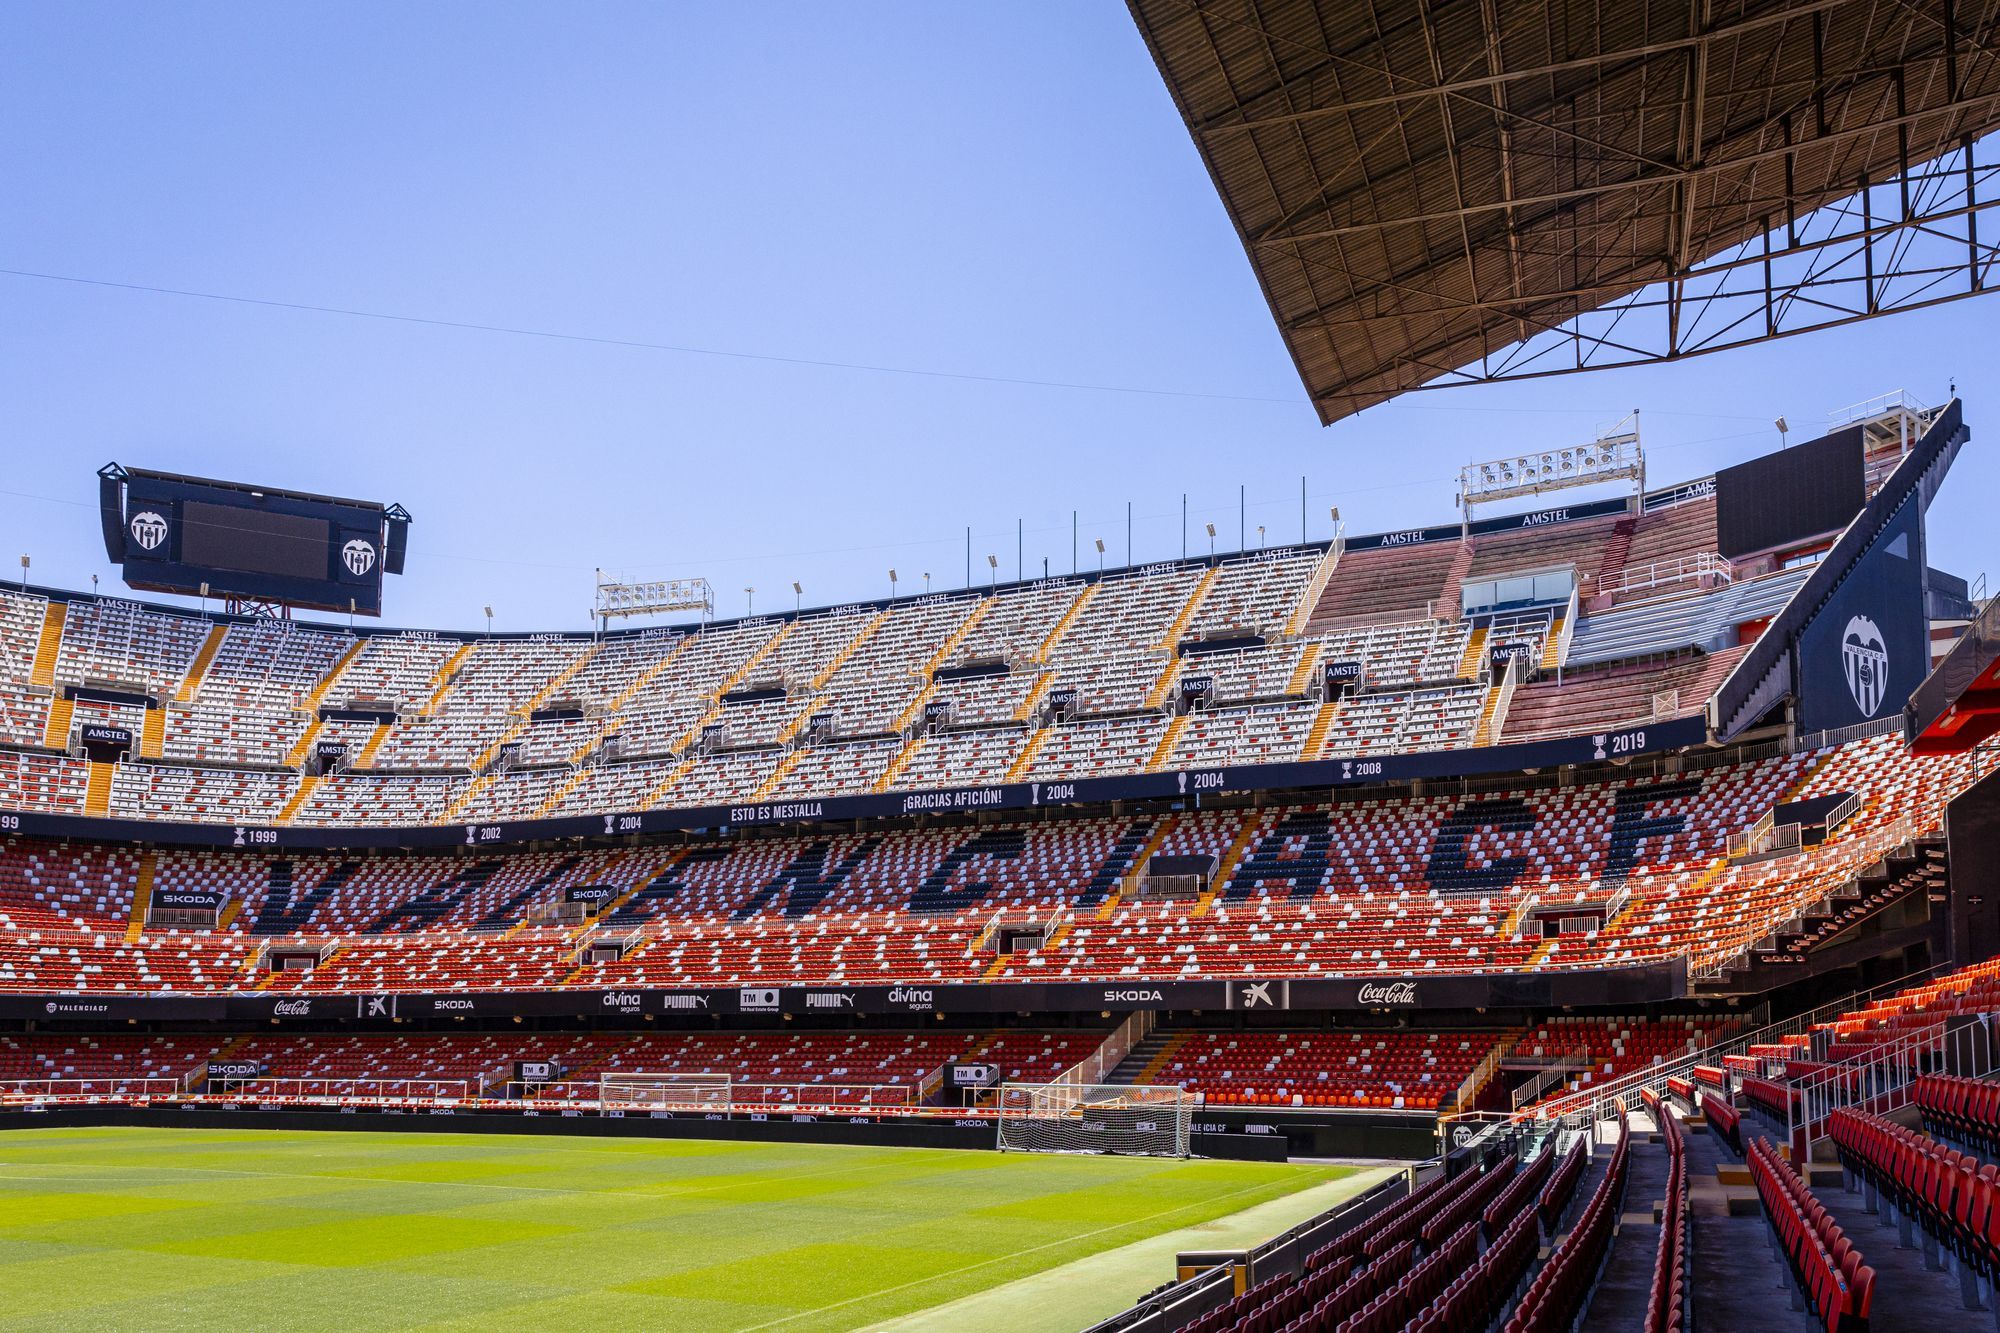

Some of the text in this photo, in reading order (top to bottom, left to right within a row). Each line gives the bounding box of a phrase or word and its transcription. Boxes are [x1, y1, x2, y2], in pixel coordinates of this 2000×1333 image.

[1686, 480, 1716, 497] AMS
[1522, 510, 1569, 527] AMSTEL
[1381, 530, 1425, 546] AMSTEL
[1254, 548, 1294, 562] AMSTEL
[1139, 562, 1177, 576] AMSTEL
[1031, 578, 1067, 590] AMSTEL
[96, 598, 144, 612] AMSTEL
[915, 594, 949, 606] AMSTEL
[830, 604, 861, 617] AMSTEL
[255, 618, 298, 631] AMSTEL
[737, 616, 768, 628] AMSTEL
[401, 630, 438, 641] AMSTEL
[529, 633, 564, 643] AMSTEL
[640, 628, 671, 638] AMSTEL
[1846, 645, 1874, 658] VALENCIA
[87, 728, 128, 741] AMSTEL
[1613, 731, 1646, 753] 2019
[1356, 762, 1381, 776] 2008
[1194, 772, 1224, 788] 2004
[1047, 784, 1075, 799] 2004
[903, 789, 1002, 812] ¡GRACIAS AFICIÓN!
[731, 803, 822, 822] ESTO ES MESTALLA
[620, 816, 642, 829] 2004
[249, 830, 277, 843] 1999
[481, 826, 501, 840] 2002
[603, 992, 640, 1006] divina
[743, 994, 756, 1003] TM
[806, 993, 842, 1008] PUMA
[888, 987, 932, 1002] divina
[664, 995, 697, 1009] PUMA
[909, 1003, 933, 1011] seguros
[956, 1070, 968, 1078] TM
[850, 1116, 869, 1124] divina
[1217, 1124, 1226, 1132] CF
[1245, 1124, 1269, 1134] PUMA
